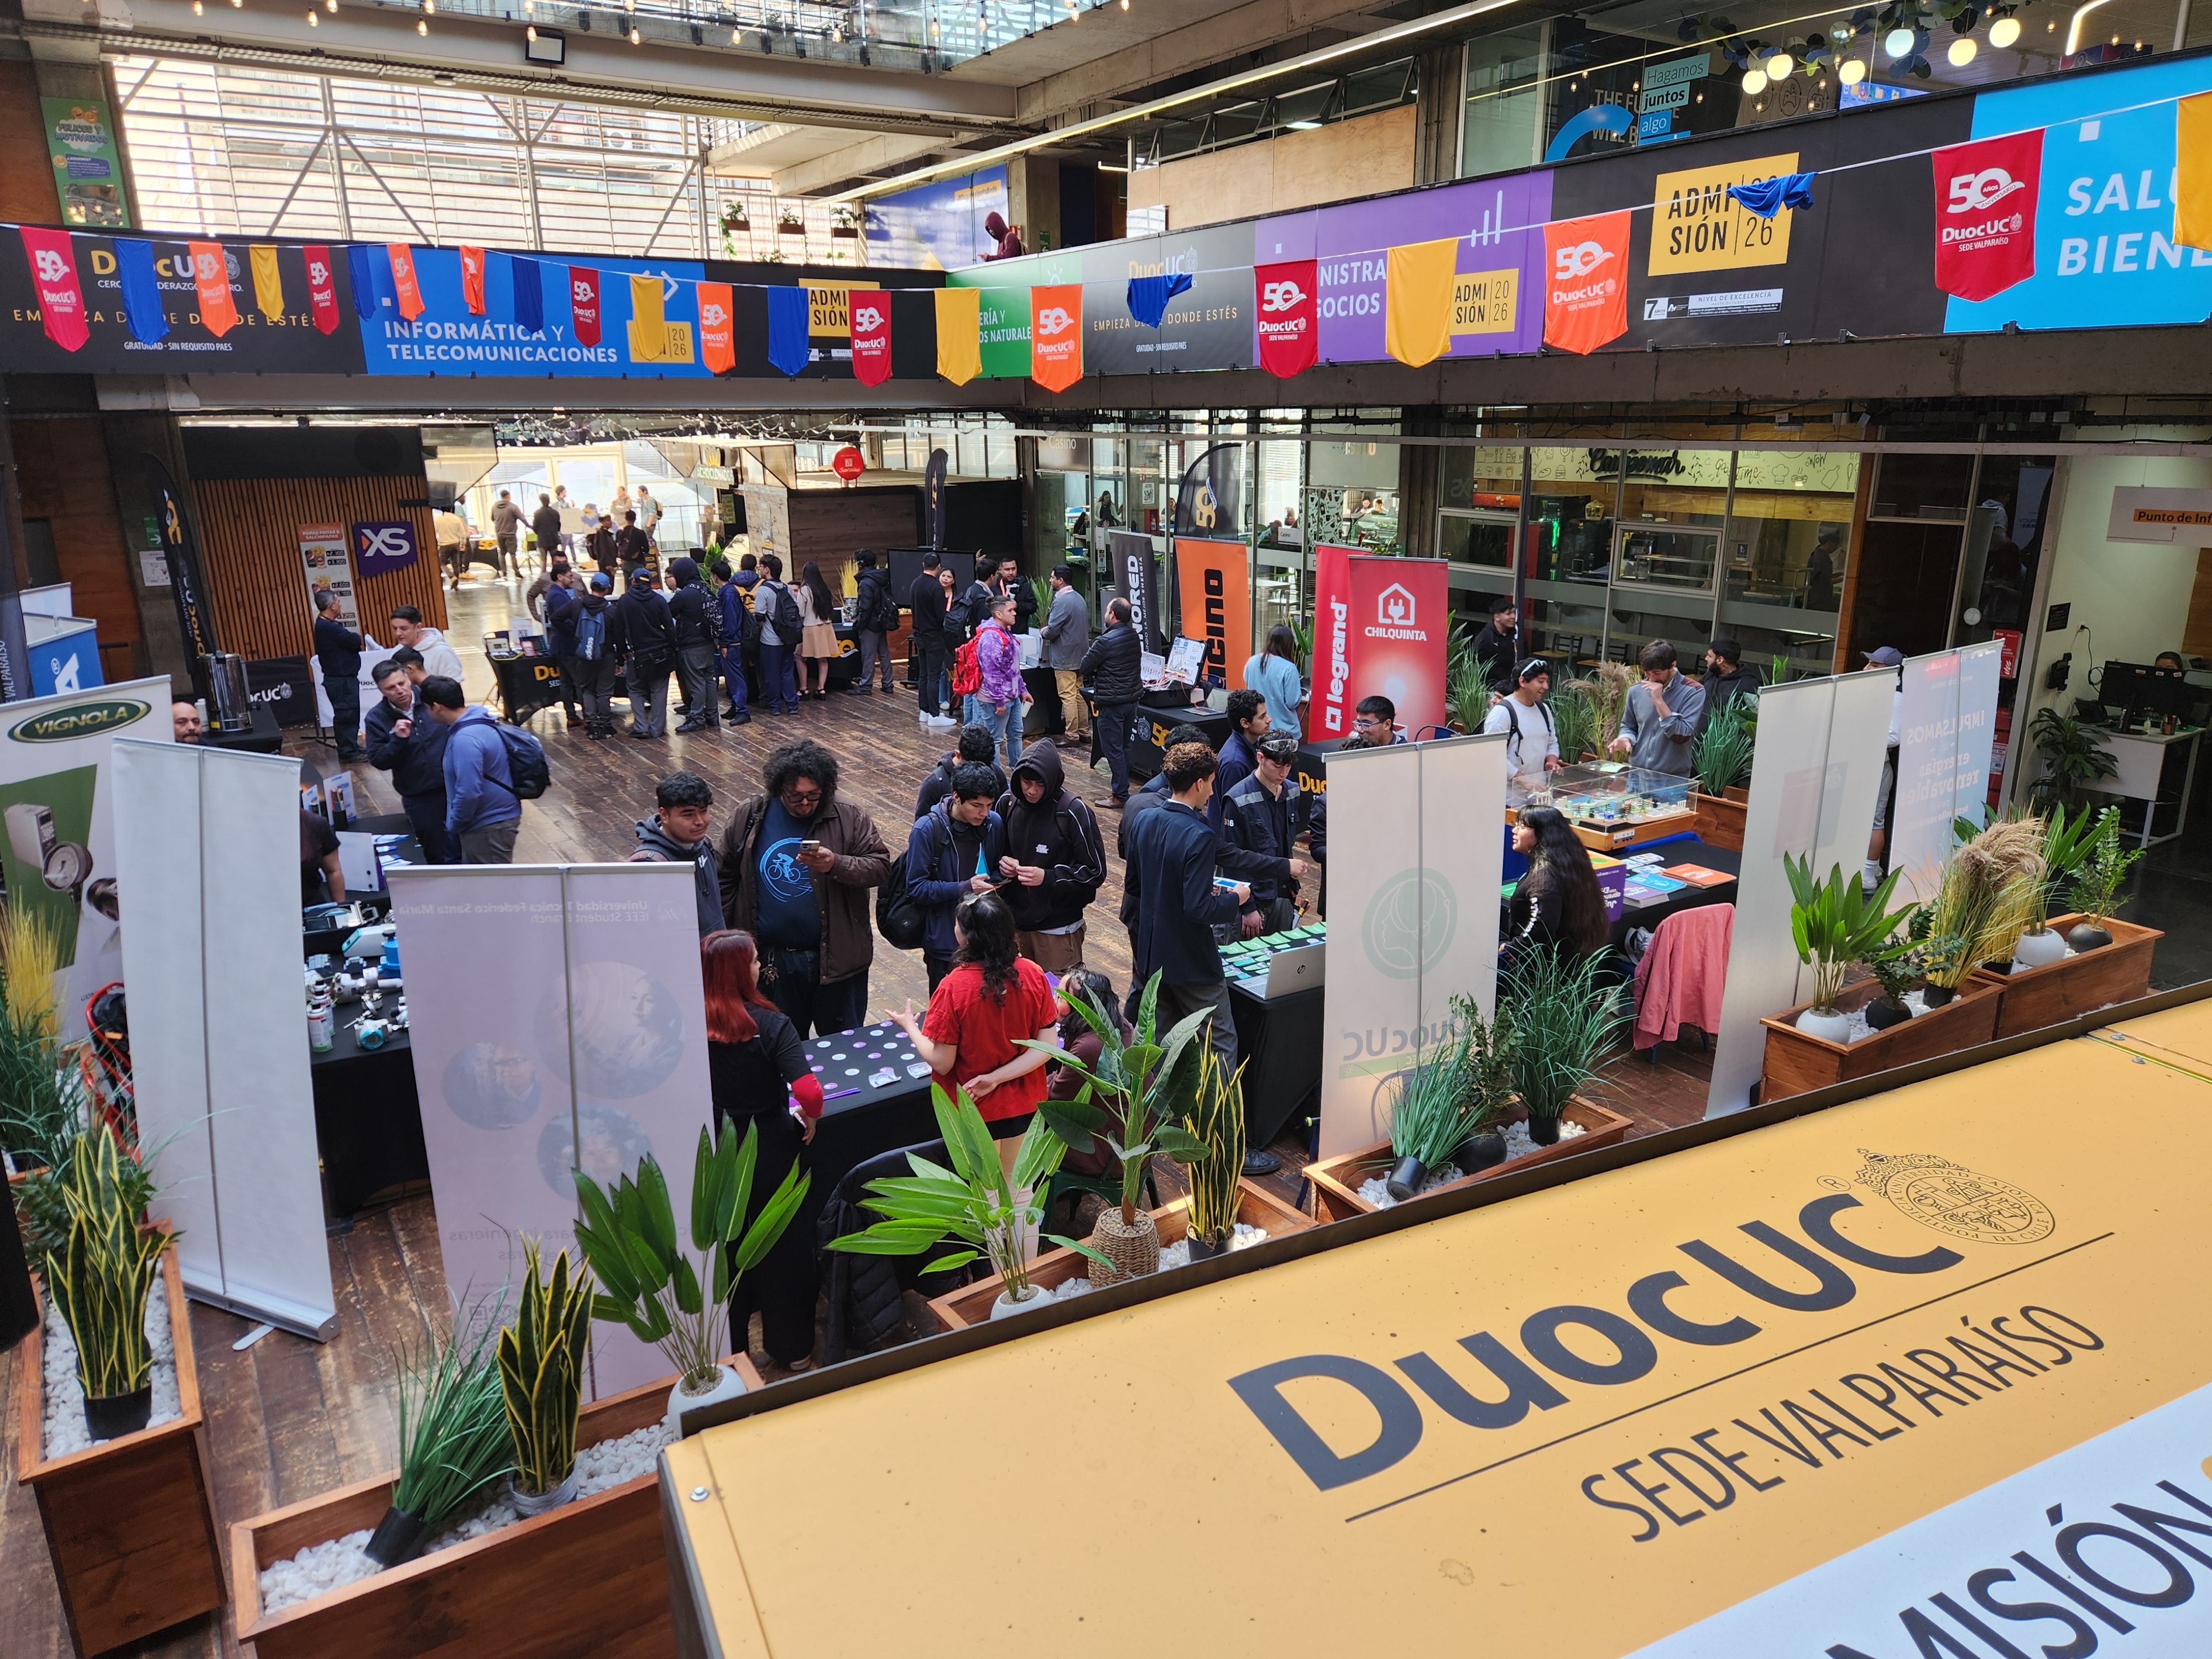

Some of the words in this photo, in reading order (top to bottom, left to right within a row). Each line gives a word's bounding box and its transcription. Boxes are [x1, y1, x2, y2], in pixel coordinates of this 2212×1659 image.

[1647, 63, 1703, 84] Hagamos
[1595, 89, 1623, 106] THE
[1644, 89, 1685, 111] juntos
[59, 123, 93, 133] FELICES
[95, 125, 102, 134] Y
[1642, 117, 1667, 133] algo
[55, 133, 108, 144] MOTIVADOS
[1668, 182, 1731, 219] ADMI
[1947, 168, 2012, 213] 50
[1981, 185, 2016, 208] ANIVERSARIO
[1670, 215, 1727, 255] SIÓN
[1745, 217, 1773, 247] 26
[1959, 242, 1974, 252] SEDE
[1974, 237, 2009, 249] VALPARAÍSO
[35, 250, 70, 282] 50
[197, 253, 220, 279] 50
[1555, 241, 1604, 280] 50
[310, 262, 328, 285] 50
[574, 281, 595, 302] 50
[810, 290, 846, 306] ADMI
[1262, 281, 1300, 311] 50
[1455, 283, 1486, 302] ADMI
[1495, 280, 1509, 299] 20
[702, 304, 723, 326] 50
[813, 306, 848, 326] SIÓN
[1316, 293, 1380, 319] GOCIOS
[1456, 301, 1485, 324] SIÓN
[1494, 303, 1507, 321] 26
[1646, 300, 1658, 319] 7
[855, 307, 880, 332] 50
[1000, 310, 1005, 324] Y
[1039, 307, 1068, 335] 50
[1094, 319, 1130, 331] EMPIEZA
[1168, 311, 1201, 325] DONDE
[1207, 305, 1237, 321] ESTÉS
[385, 320, 546, 341] INFORMÁTICA
[551, 326, 564, 341] Y
[672, 328, 685, 341] 20
[991, 326, 1031, 343] NATURALE
[124, 341, 163, 350] GRATUIDAD
[168, 342, 179, 351] SIN
[180, 342, 215, 351] REQUISITO
[216, 343, 232, 351] PAES
[387, 344, 618, 363] TELECOMUNICACIONES
[674, 343, 686, 356] 26
[1162, 342, 1178, 351] REQUISITO
[1178, 341, 1187, 349] PAES
[1049, 436, 1076, 450] Casino
[1196, 486, 1215, 529] 50
[2138, 511, 2174, 522] Punto
[2177, 513, 2192, 523] de
[361, 528, 410, 557] XS
[1144, 621, 1149, 630] LA
[1365, 626, 1427, 641] CHILQUINTA
[1327, 602, 1349, 703] legrand
[34, 706, 128, 735] VIGNOLA
[1890, 1168, 1970, 1194] UNIVERSIDAD
[1978, 1176, 2046, 1214] CATÓLICA
[1896, 1197, 1980, 1240] PONTIFICIA
[1992, 1235, 2017, 1243] DE
[2020, 1218, 2049, 1240] CHILE
[1227, 1193, 1966, 1491] DuocUC
[1581, 1428, 1786, 1542] SEDE
[1731, 1306, 2105, 1469] VALPARAÍSO
